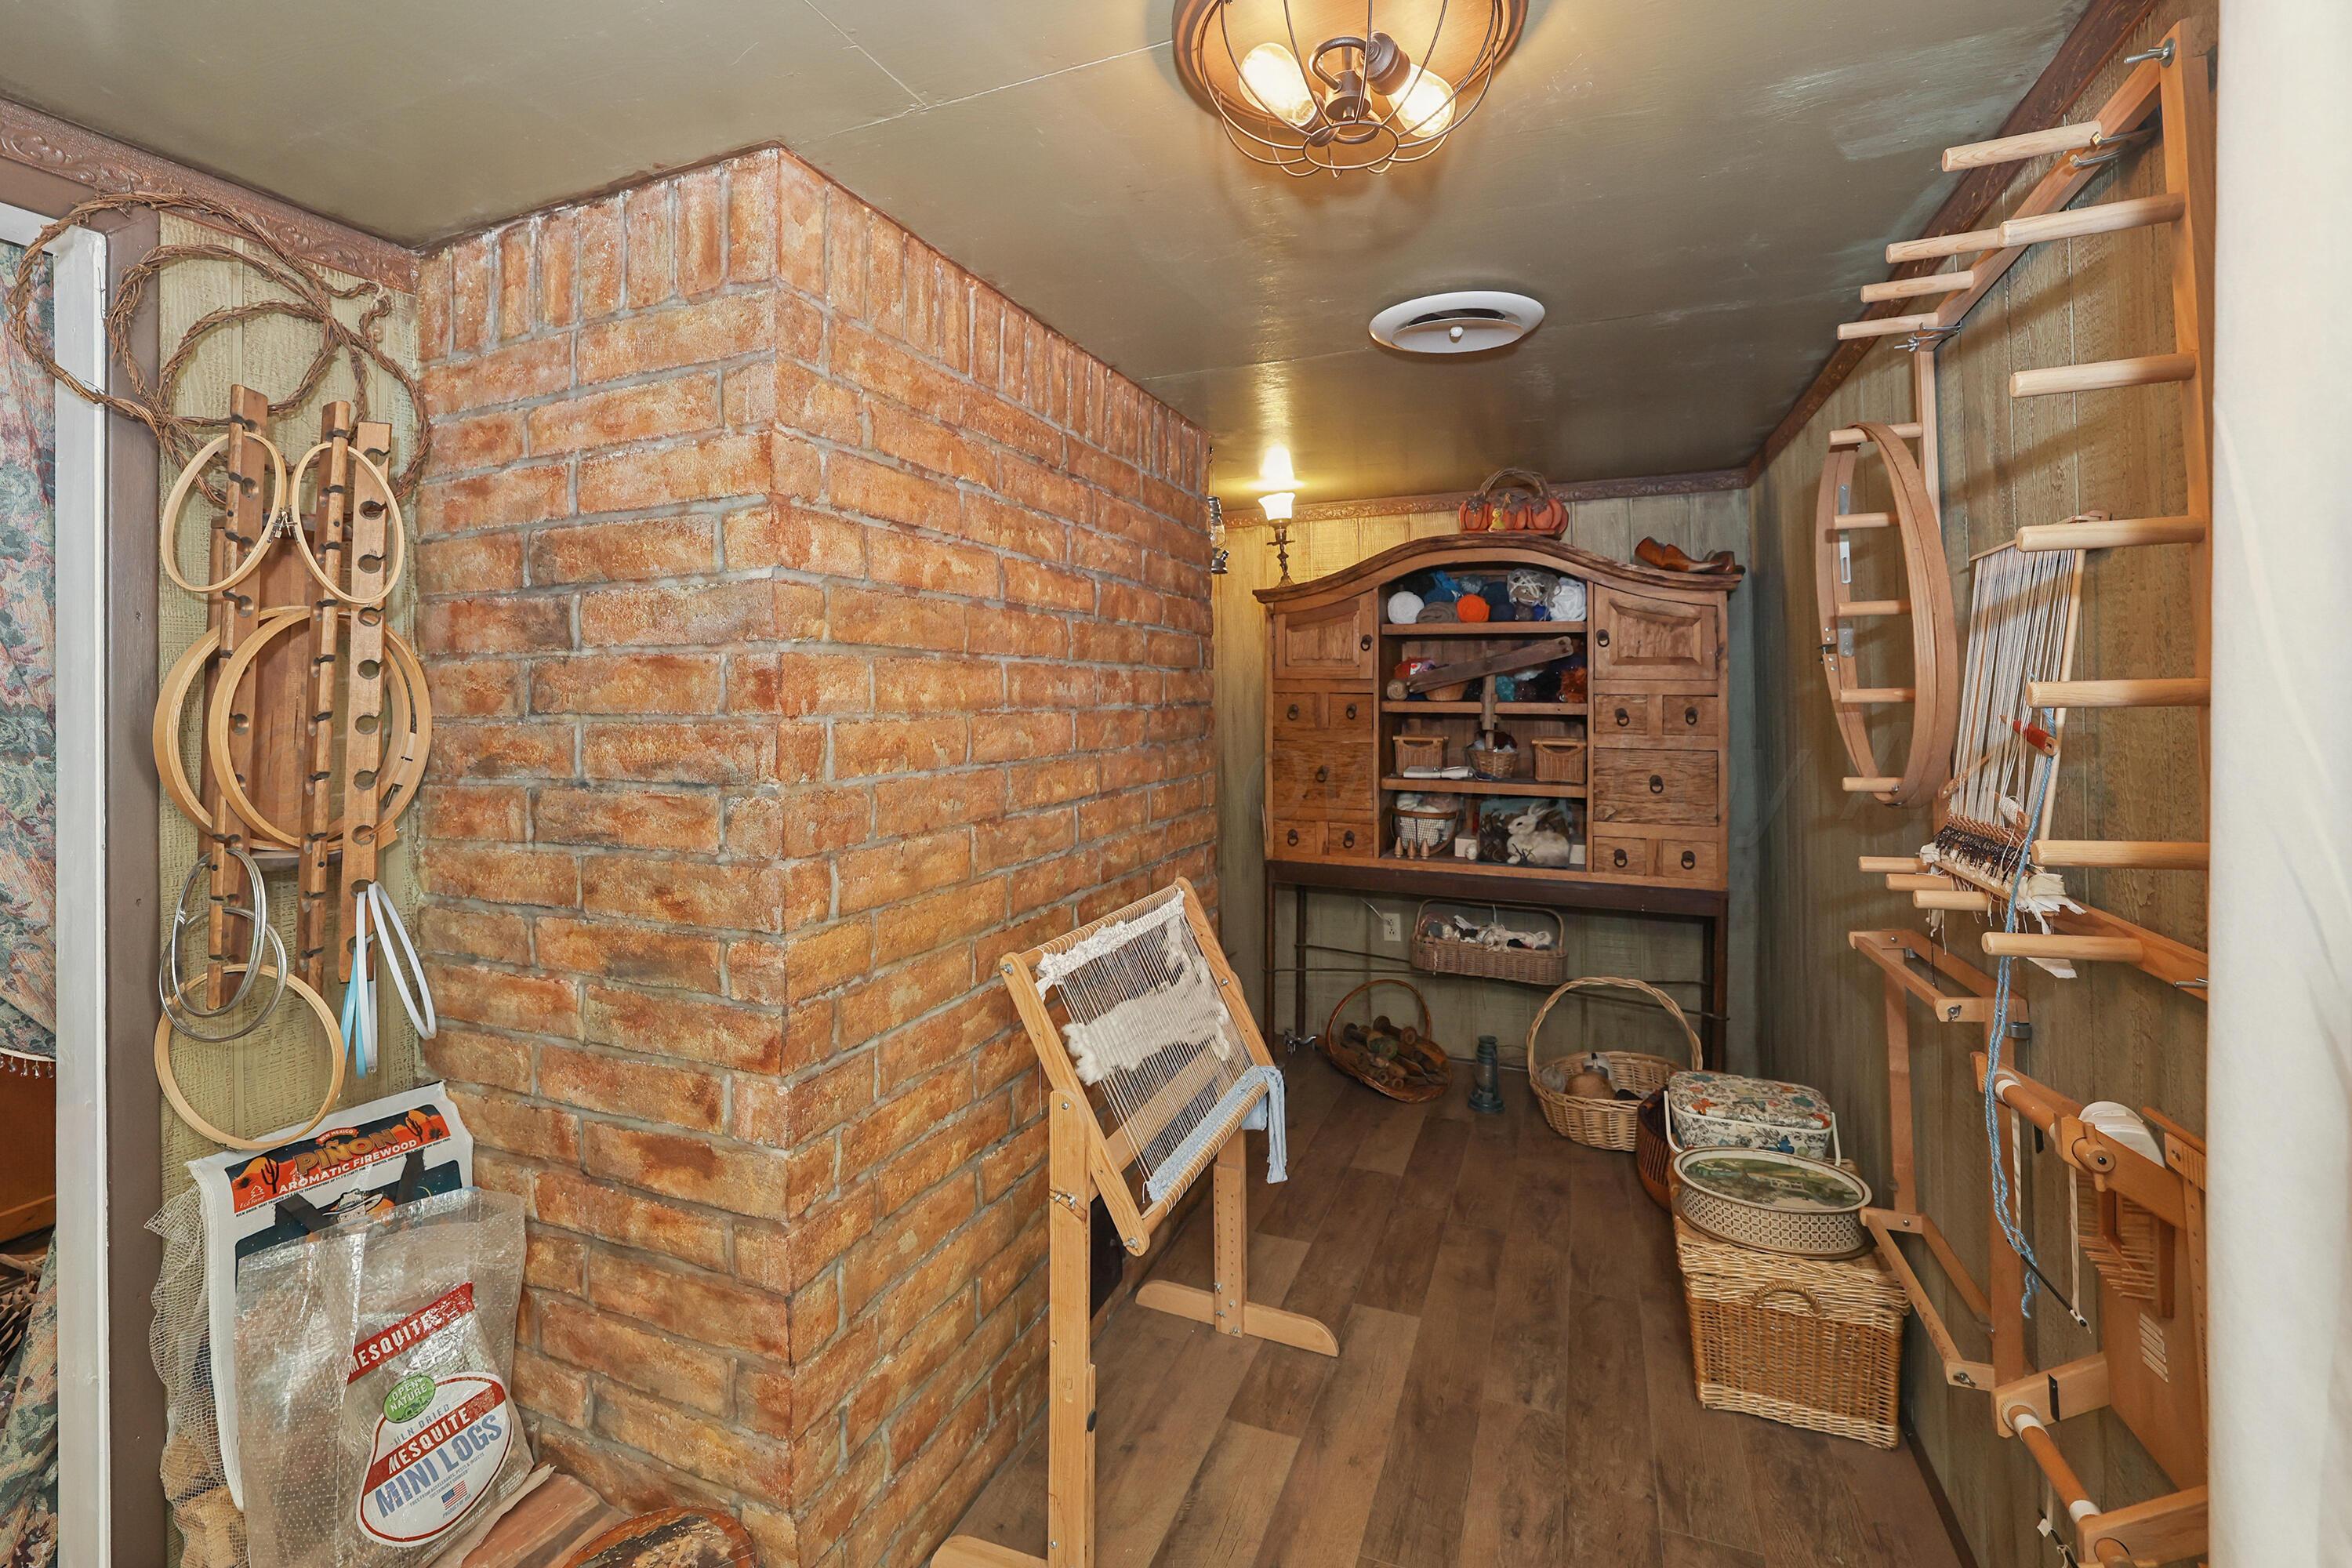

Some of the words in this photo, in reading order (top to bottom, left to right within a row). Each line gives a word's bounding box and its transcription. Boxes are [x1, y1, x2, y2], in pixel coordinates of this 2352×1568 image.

[292, 1128, 398, 1176] PIÑON
[319, 1133, 330, 1142] NEW
[279, 1163, 350, 1194] AROMATIC
[353, 1139, 417, 1167] FIREWOOD
[390, 1384, 428, 1412] NATURE
[392, 1378, 423, 1402] OPEN
[419, 1404, 450, 1428] DRIED
[389, 1407, 470, 1474] MESQUITE
[376, 1457, 439, 1518] MINI
[436, 1414, 502, 1472] LOGS
